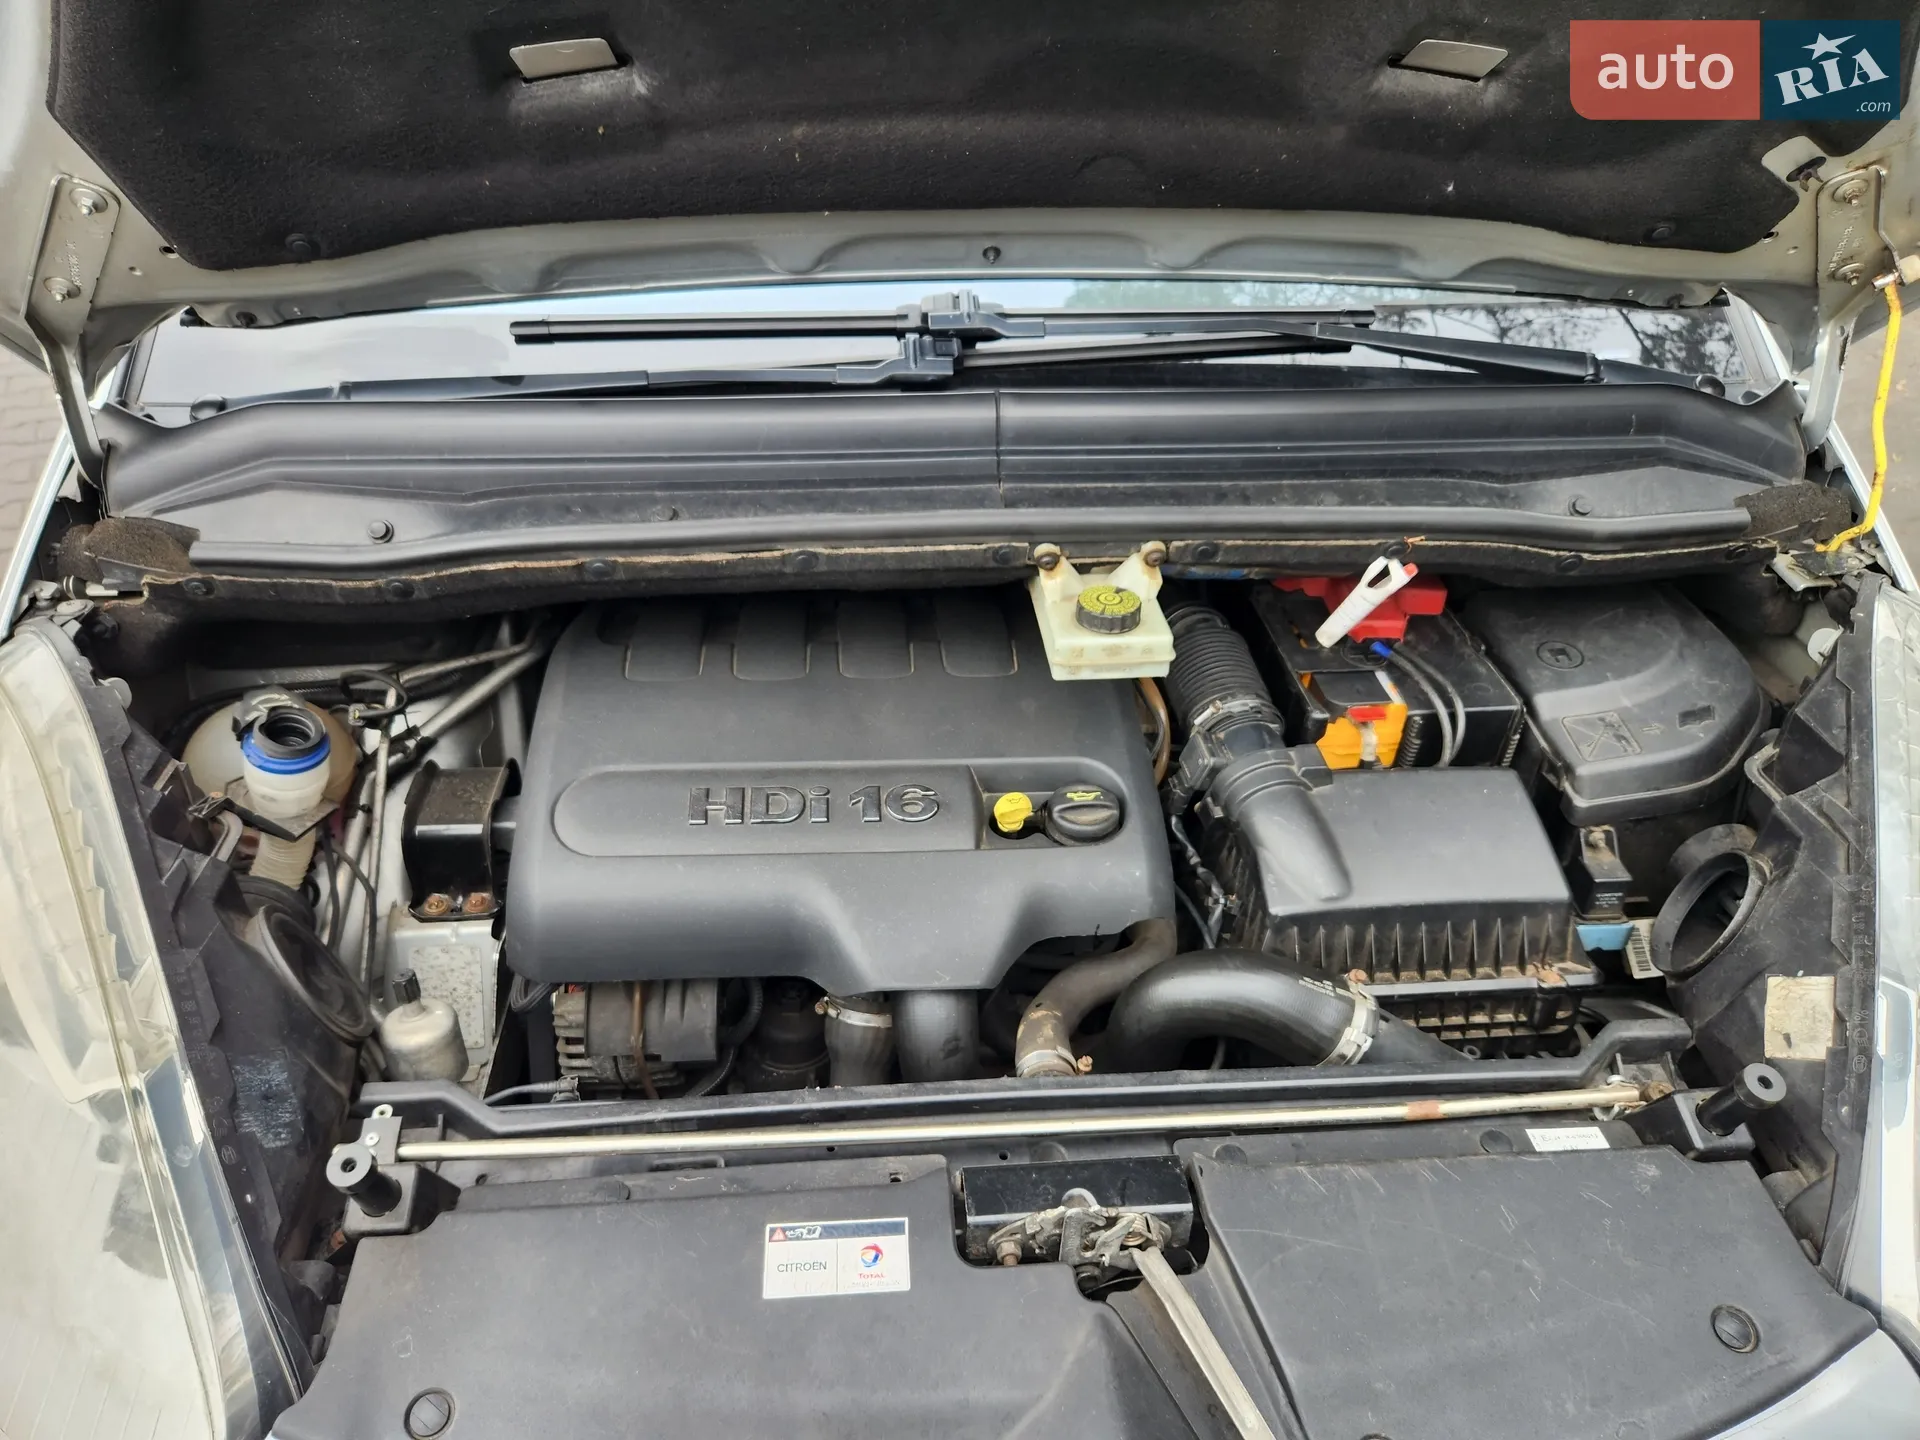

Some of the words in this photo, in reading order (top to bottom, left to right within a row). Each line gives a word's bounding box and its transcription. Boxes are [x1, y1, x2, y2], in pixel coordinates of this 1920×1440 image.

[688, 784, 830, 825] HDi
[848, 784, 940, 823] 16
[776, 1261, 828, 1273] CITROËN
